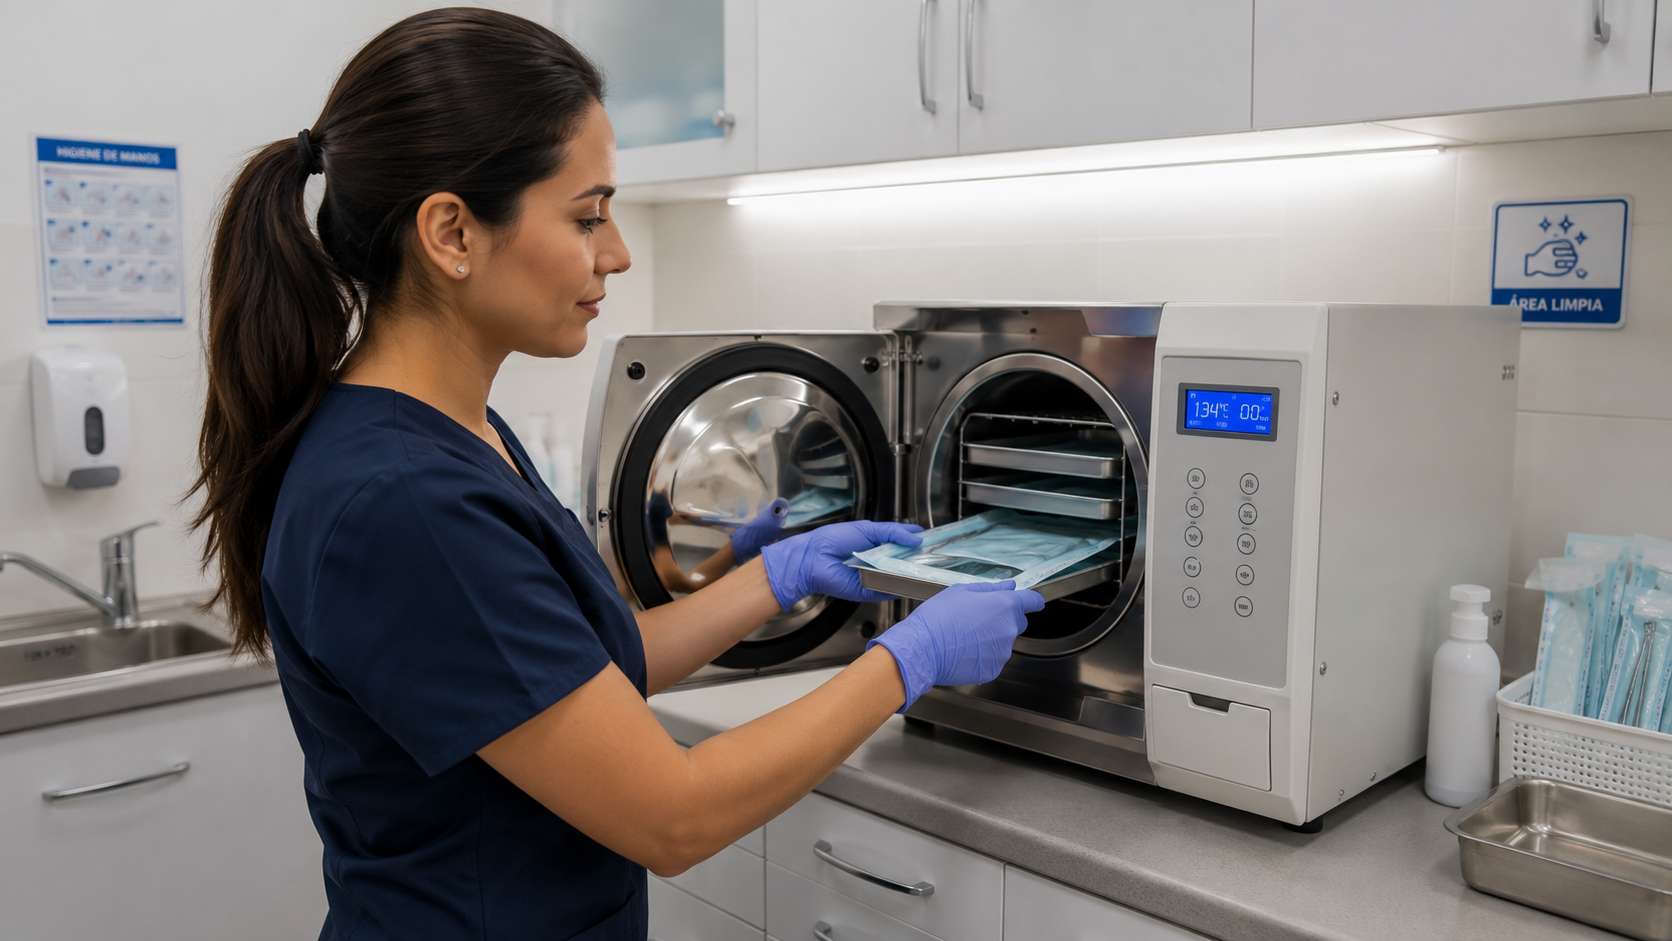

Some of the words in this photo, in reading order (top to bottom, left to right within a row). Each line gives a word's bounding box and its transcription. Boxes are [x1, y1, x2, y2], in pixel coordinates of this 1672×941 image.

[56, 146, 101, 160] HIGIENE
[103, 149, 118, 161] DE
[120, 151, 160, 165] MANOS
[1510, 294, 1547, 311] ÁREA
[1551, 298, 1603, 311] LIMPIA
